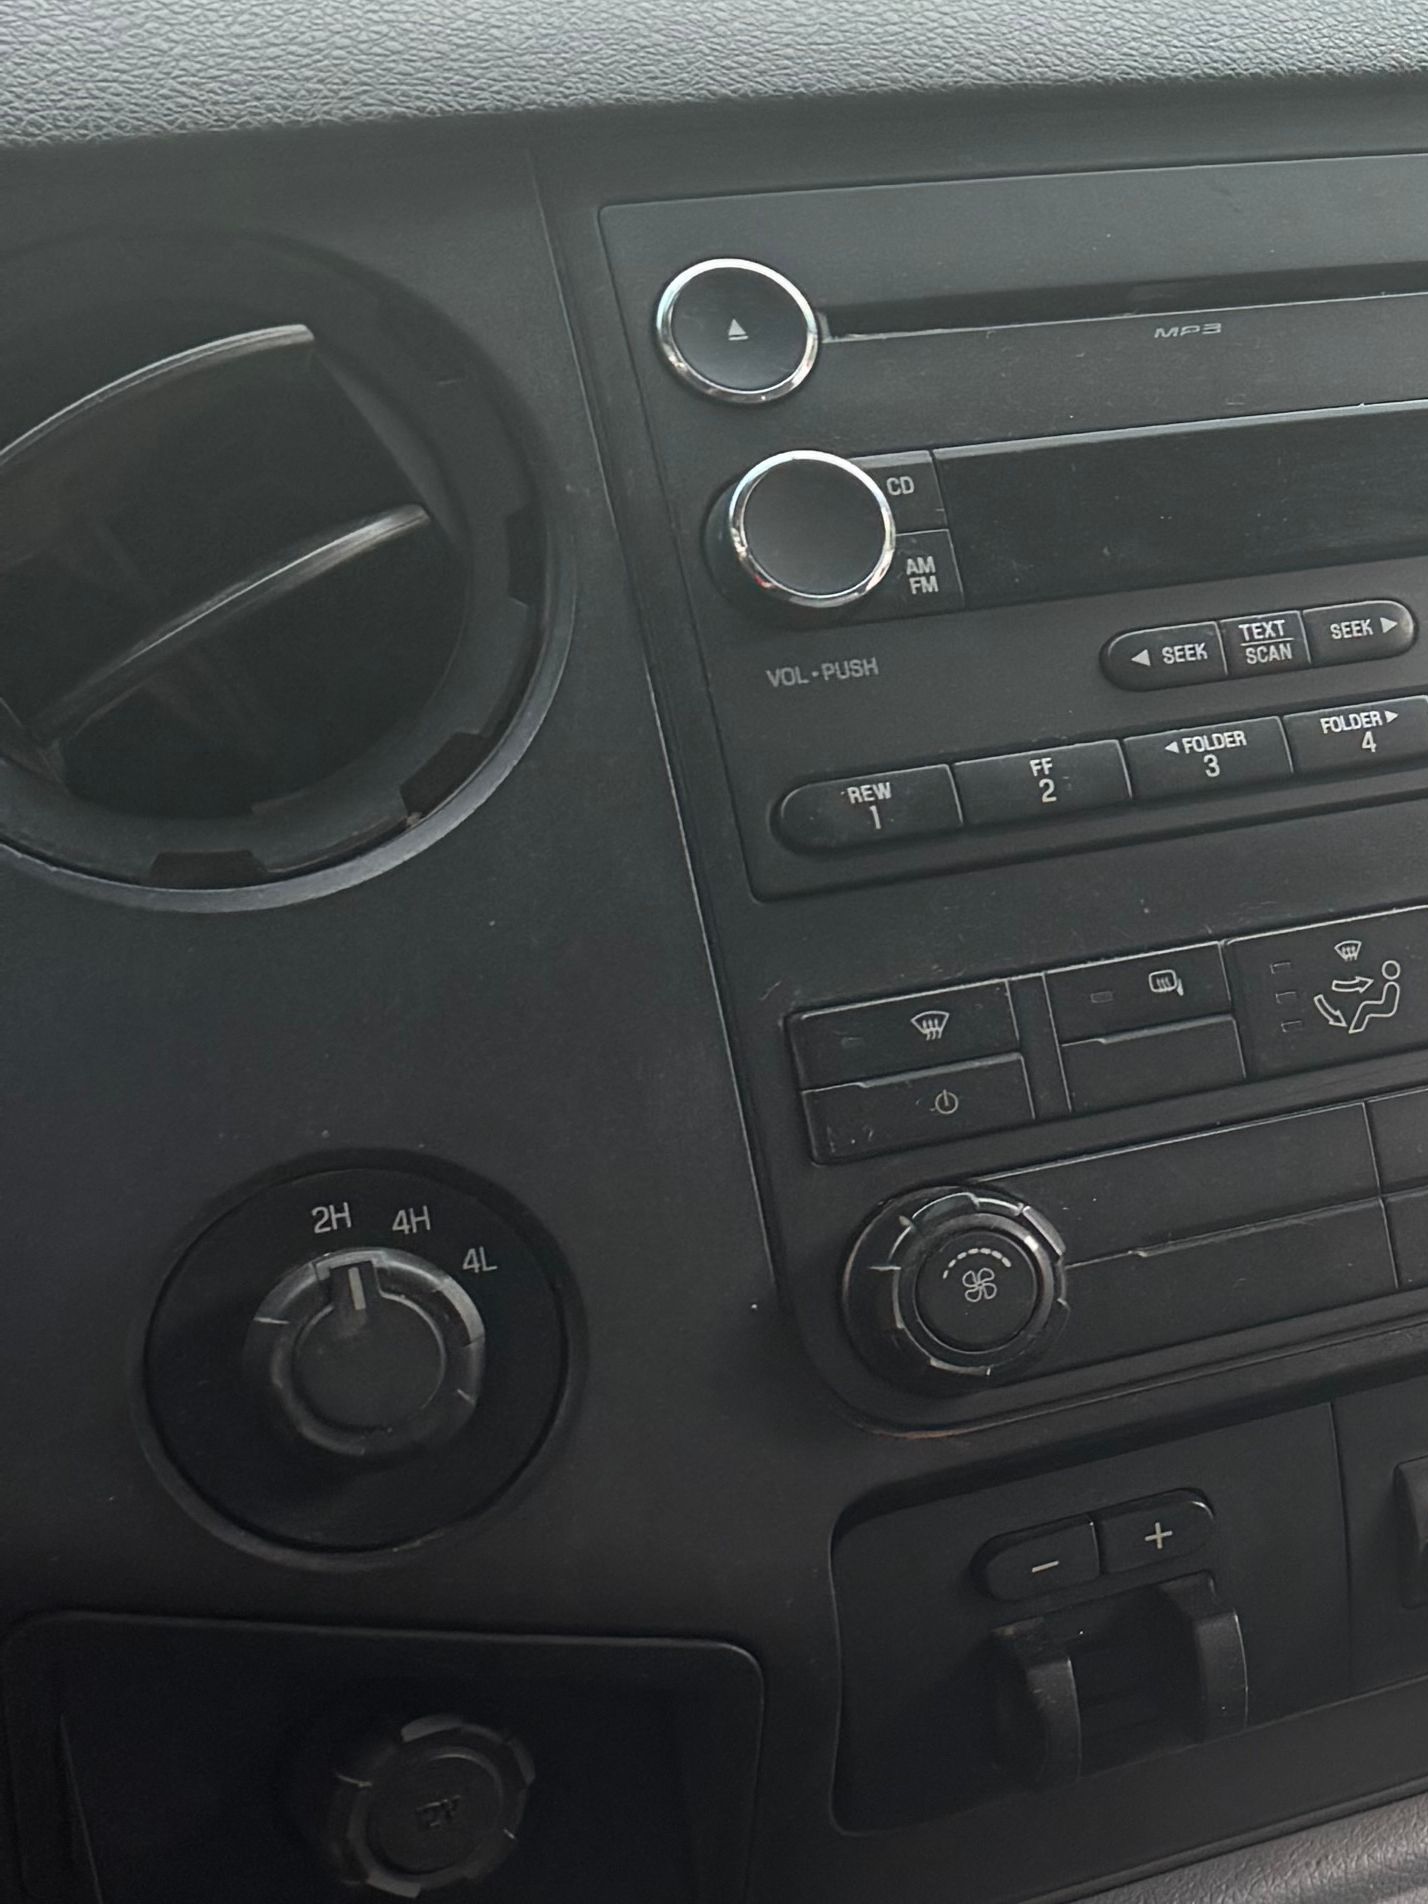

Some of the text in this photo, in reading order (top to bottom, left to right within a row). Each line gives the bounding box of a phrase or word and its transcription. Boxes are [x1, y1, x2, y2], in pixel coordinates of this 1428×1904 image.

[1154, 322, 1222, 338] MP3
[886, 476, 914, 495] CD
[906, 556, 936, 575] AM
[909, 576, 939, 594] FM
[1238, 620, 1286, 642] TEXT
[1330, 619, 1374, 640] SEEK
[1161, 642, 1208, 665] SEEK
[1245, 643, 1293, 665] SCAN
[1319, 711, 1383, 734] FOLDER
[1182, 729, 1248, 754] FOLDER
[1361, 730, 1377, 754] 4
[1030, 757, 1054, 778] FF
[1203, 753, 1221, 778] 3
[847, 781, 893, 805] REW
[1038, 778, 1057, 804] 2
[868, 804, 882, 830] 1
[311, 1201, 352, 1234] 2H
[391, 1205, 431, 1235] 4H
[462, 1246, 498, 1273] 4L
